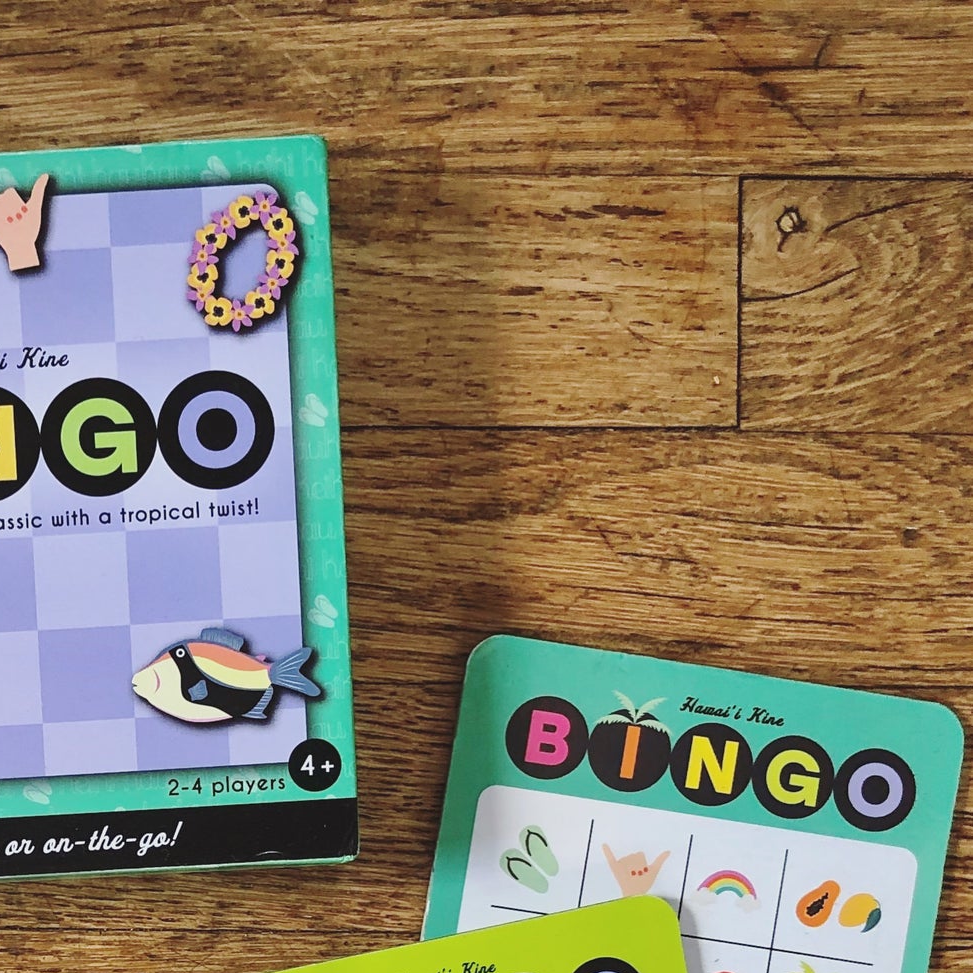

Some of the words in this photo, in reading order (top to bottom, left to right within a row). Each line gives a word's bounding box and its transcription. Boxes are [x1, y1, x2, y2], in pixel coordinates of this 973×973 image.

[16, 346, 70, 369] Kine
[50, 507, 90, 529] with
[98, 511, 112, 525] a
[119, 501, 200, 526] tropical
[208, 497, 260, 518] twist!
[746, 706, 785, 727] Kine
[299, 753, 335, 776] 4+
[523, 709, 904, 818] BINGO
[167, 777, 203, 796] 2-4
[211, 775, 286, 797] players
[3, 838, 36, 857] or
[42, 820, 184, 857] on-the-go!
